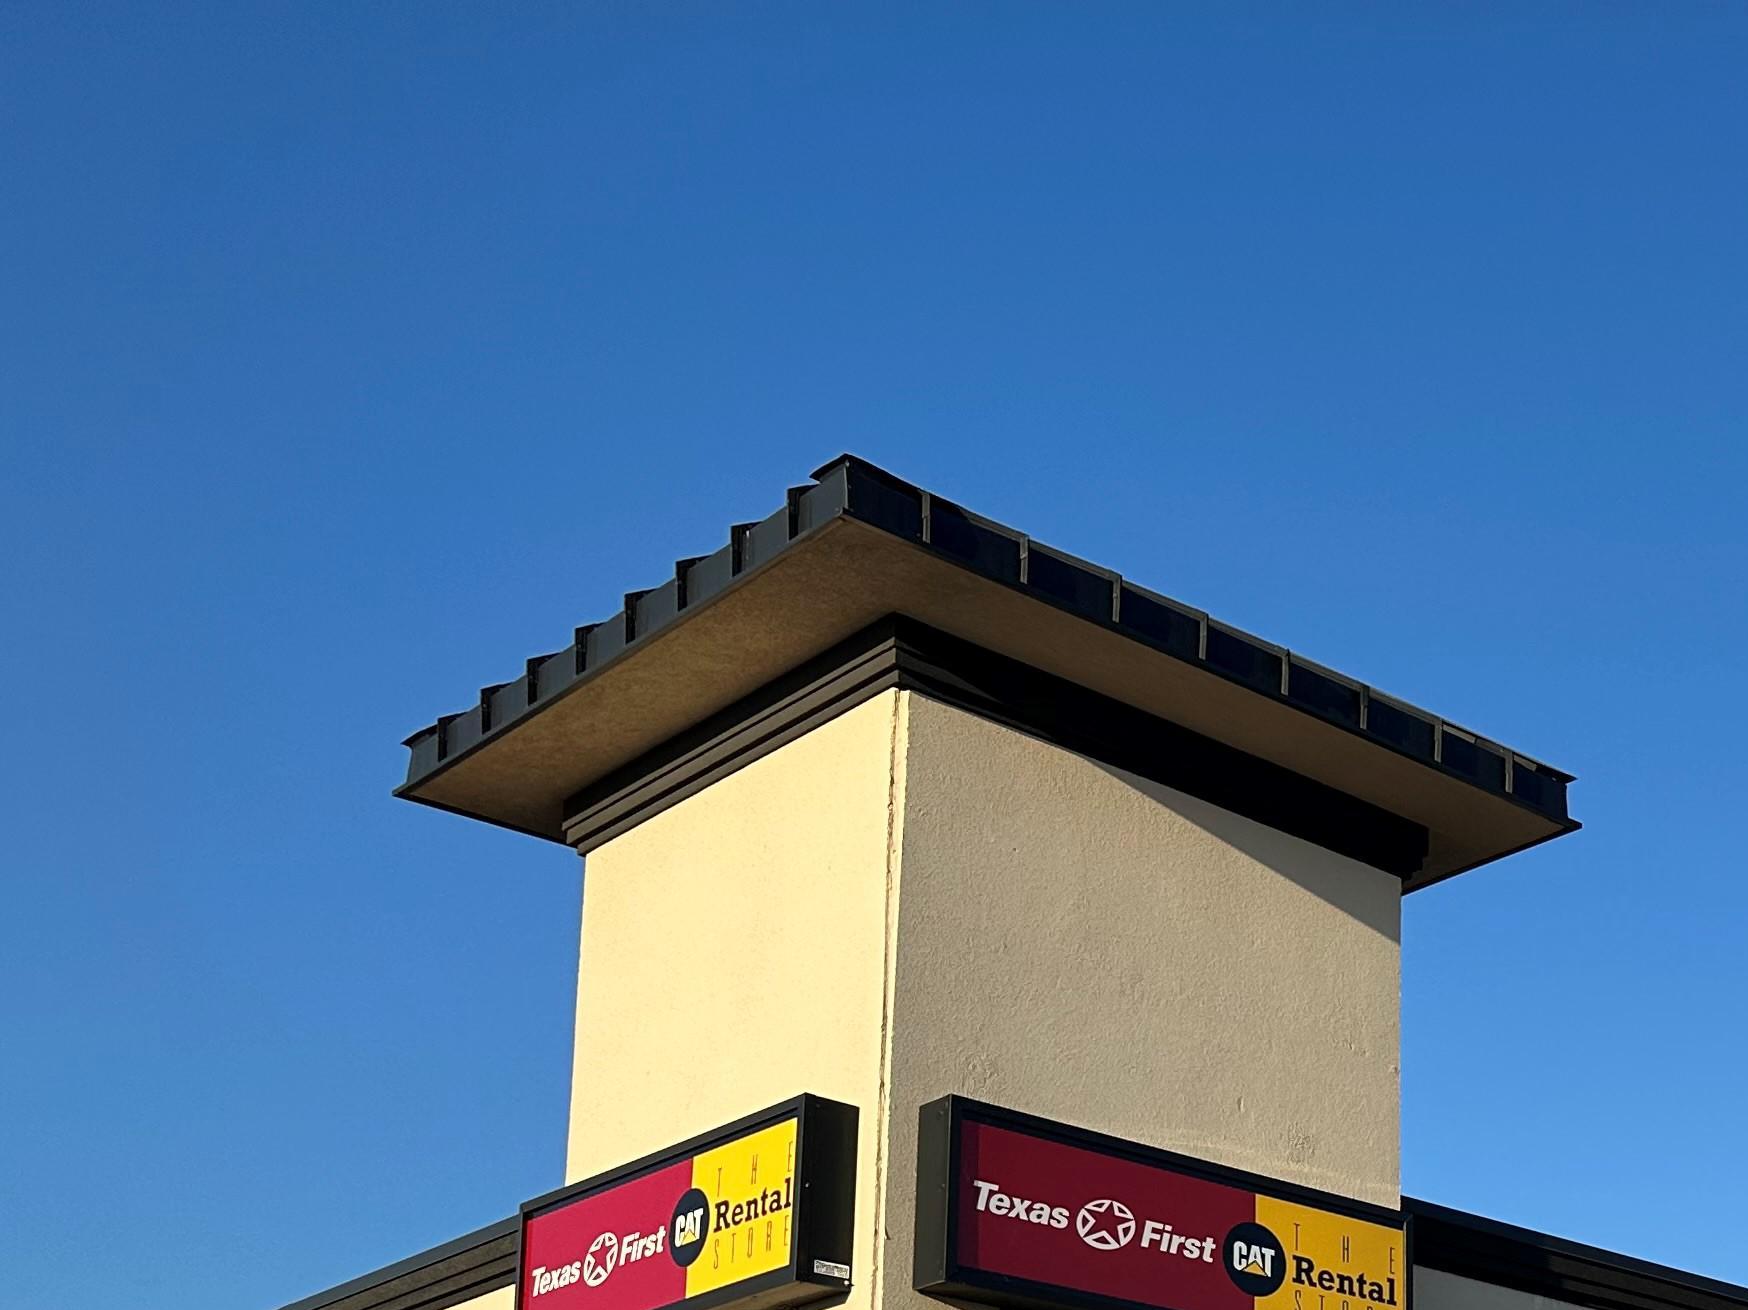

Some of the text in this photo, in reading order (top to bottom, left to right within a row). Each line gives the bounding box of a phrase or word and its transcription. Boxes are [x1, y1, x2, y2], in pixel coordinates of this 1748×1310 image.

[674, 1207, 704, 1248] CAT
[713, 1177, 792, 1234] Rental
[973, 1180, 1216, 1264] Texas First
[532, 1225, 667, 1298] Texas First
[713, 1215, 790, 1270] STORE
[1233, 1240, 1275, 1278] CAT
[1292, 1254, 1398, 1307] Rental
